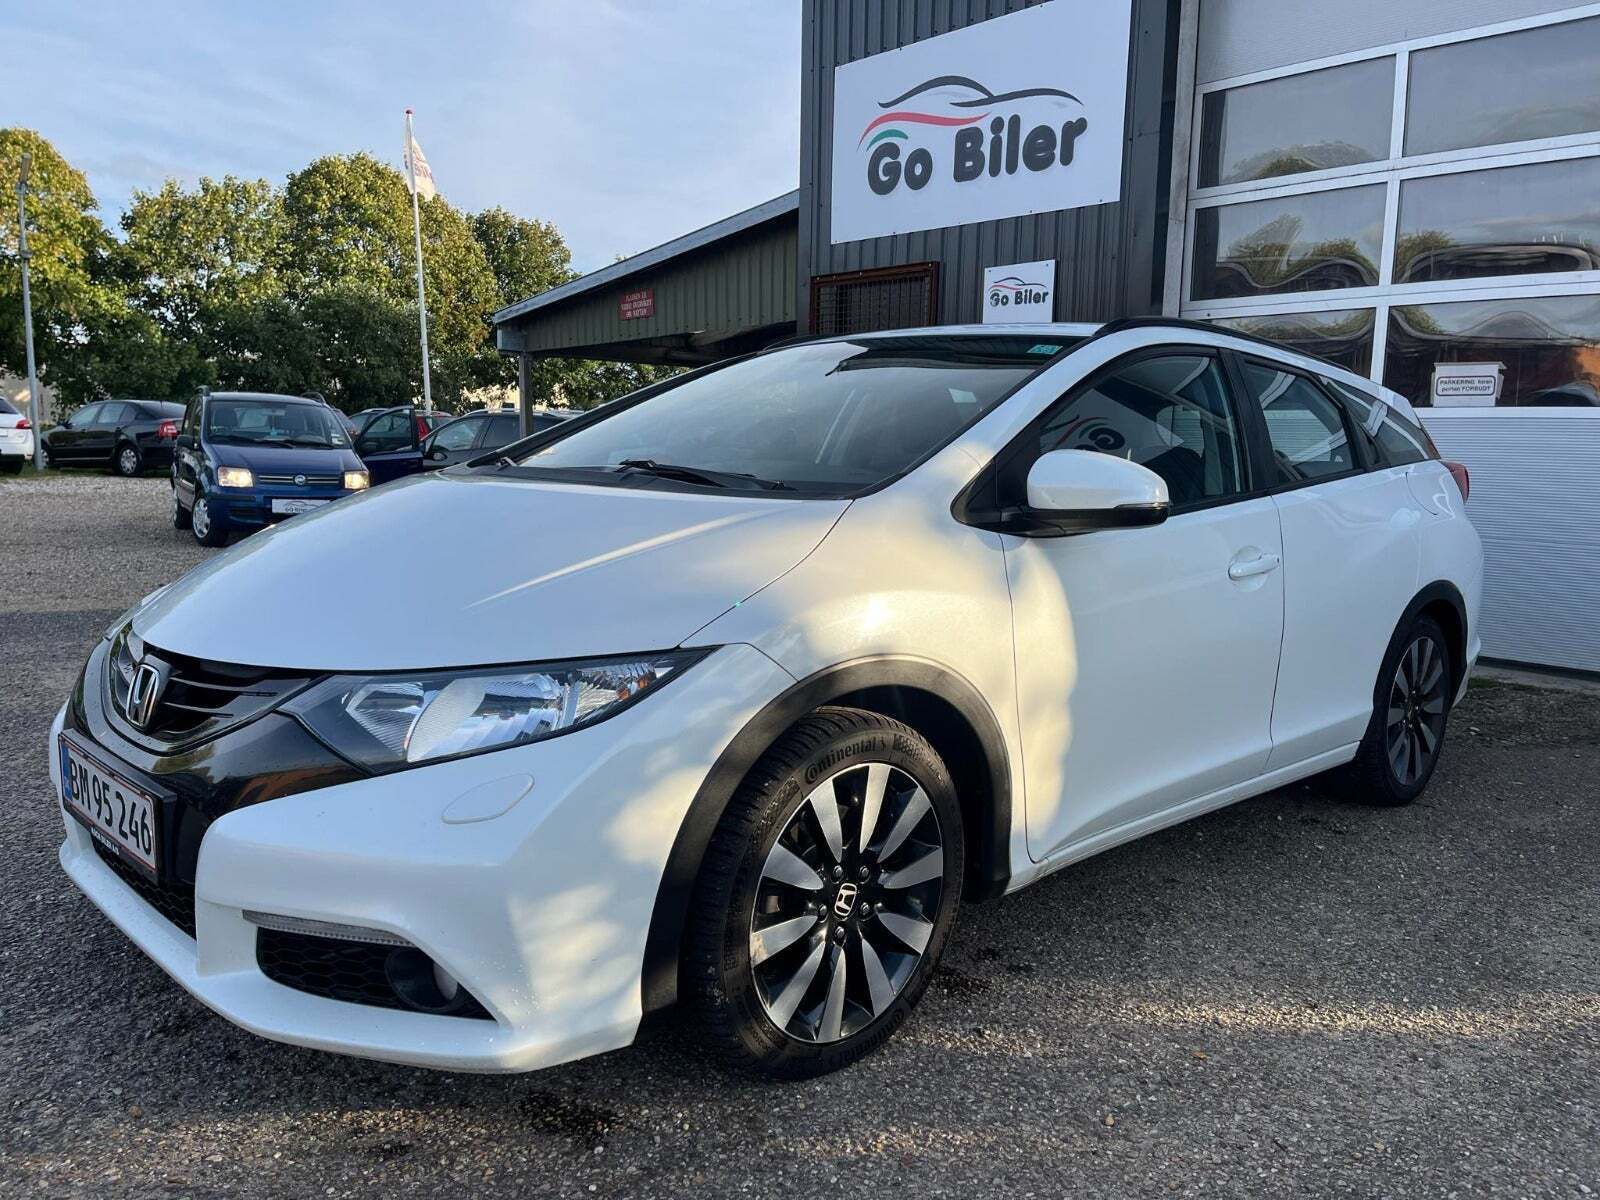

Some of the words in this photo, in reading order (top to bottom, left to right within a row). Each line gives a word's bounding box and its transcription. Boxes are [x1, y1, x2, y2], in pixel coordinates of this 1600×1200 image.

[867, 141, 933, 195] Go
[953, 113, 1088, 183] Biler
[989, 292, 1010, 307] Go
[1014, 288, 1049, 305] Biler
[1462, 385, 1490, 393] FORBUDT
[804, 736, 877, 784] Continental
[70, 757, 91, 811] BM
[92, 774, 113, 828] 95
[115, 790, 152, 856] 246
